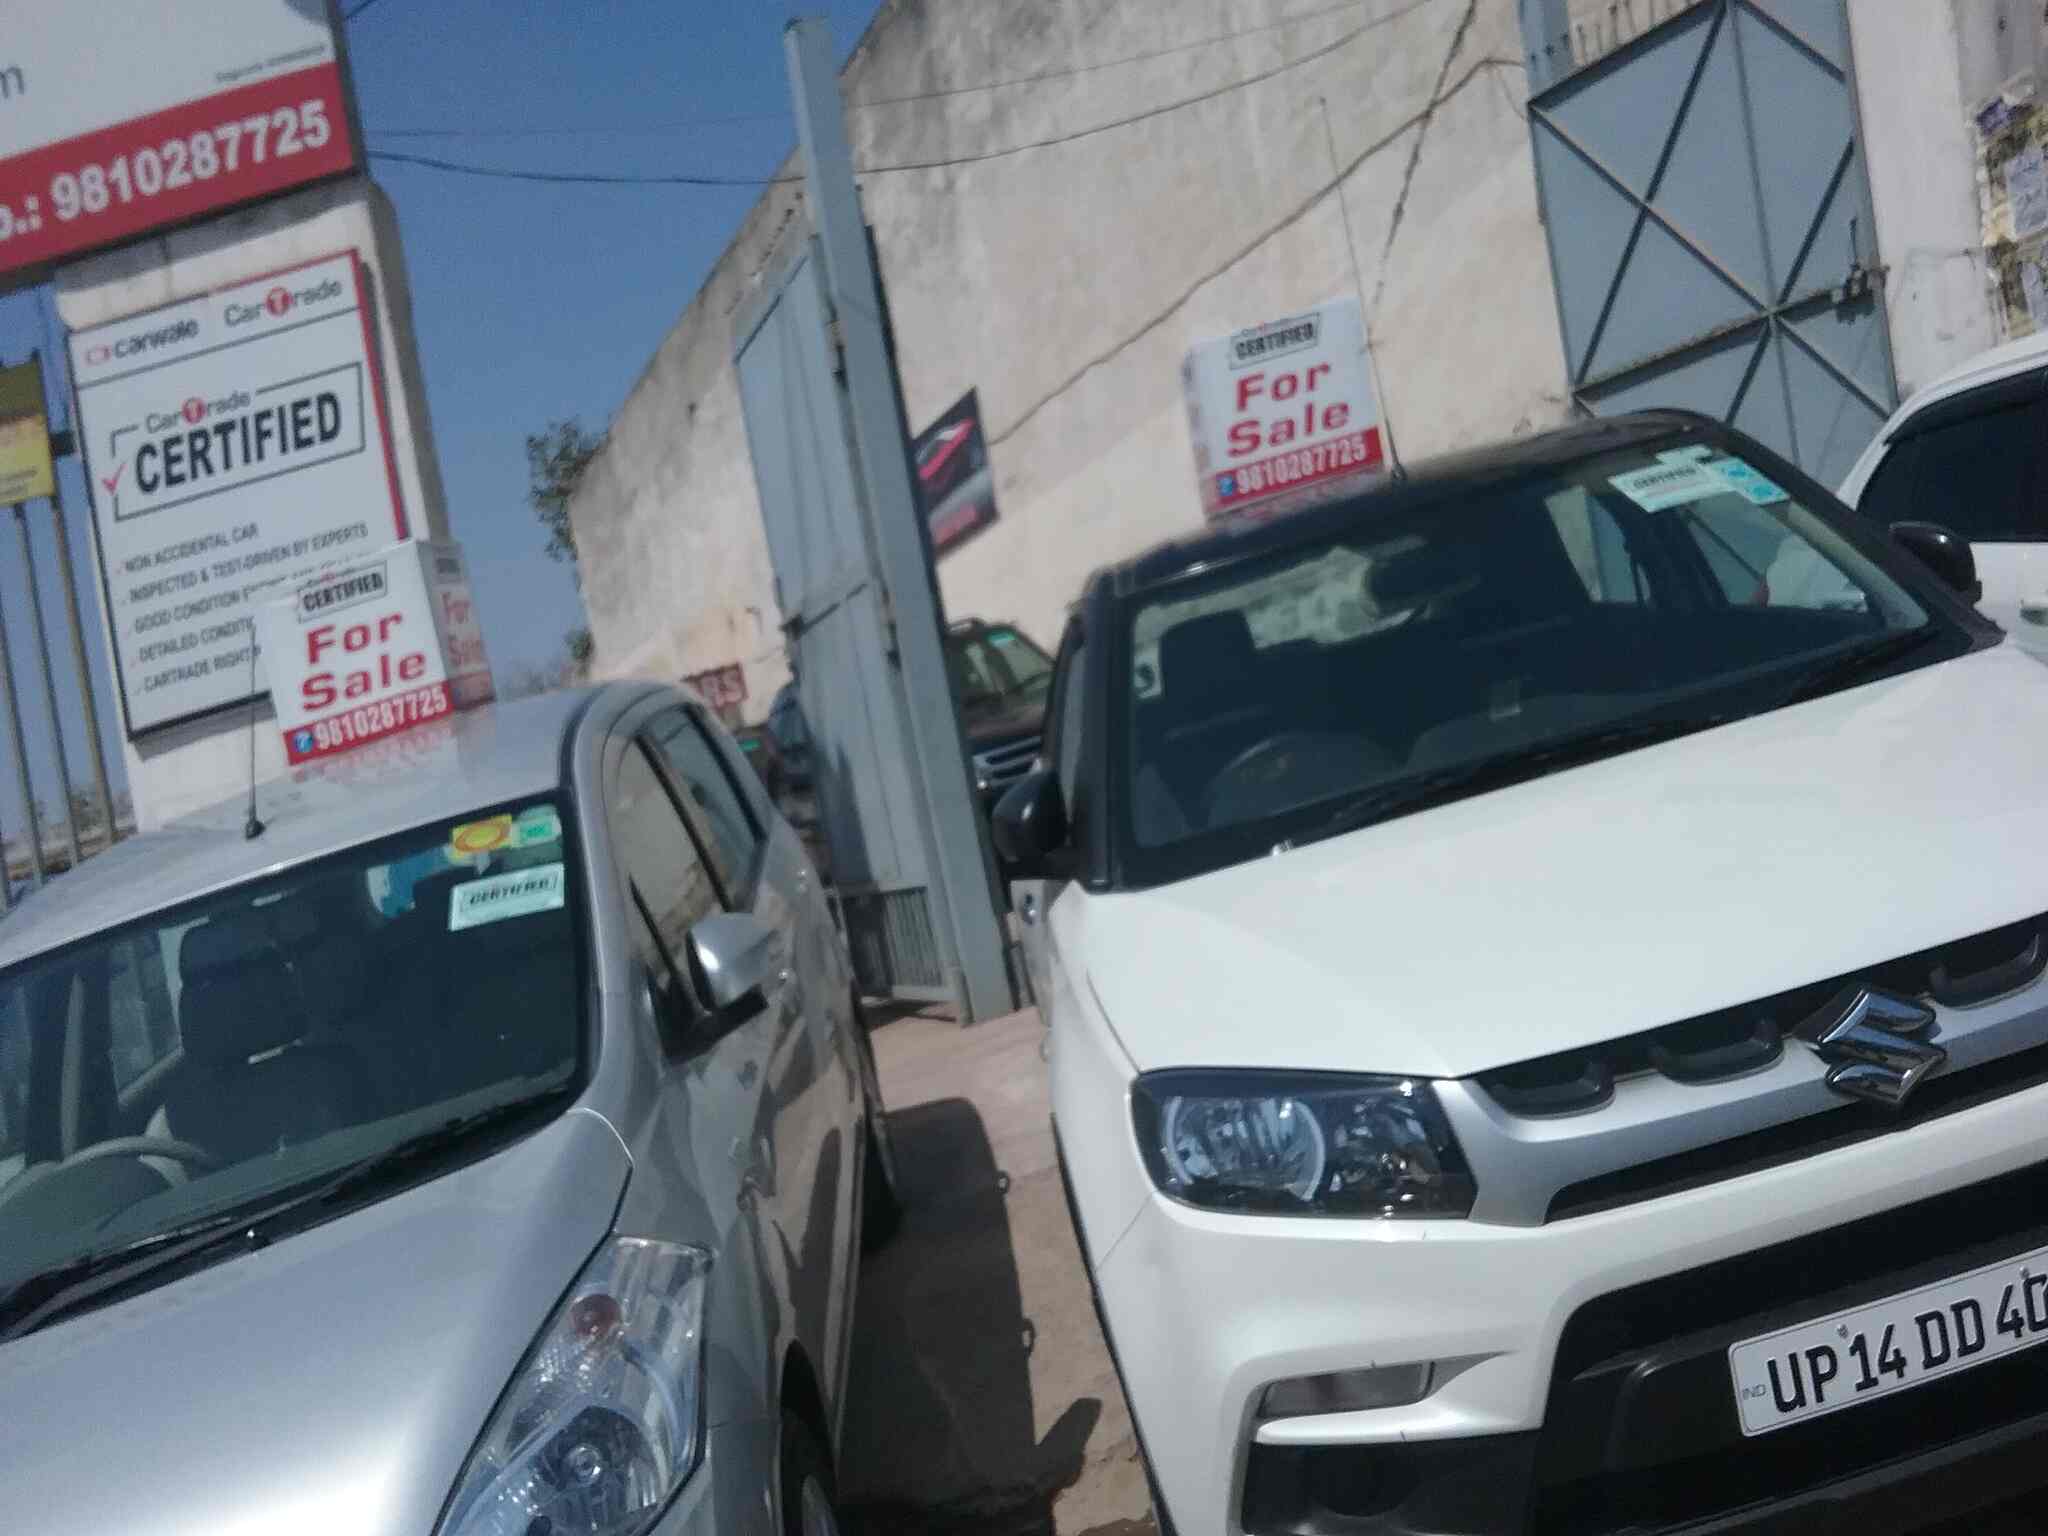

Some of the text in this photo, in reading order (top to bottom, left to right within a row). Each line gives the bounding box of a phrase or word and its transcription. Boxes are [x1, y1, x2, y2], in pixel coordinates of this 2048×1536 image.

[50, 100, 330, 221] 9810287725
[1234, 322, 1314, 360] CERTIFIED
[1236, 362, 1330, 411] For
[135, 391, 342, 494] CERTIFIED
[1227, 402, 1350, 458] Sale
[1235, 435, 1368, 495] 9810287725
[232, 522, 258, 543] CAR
[303, 572, 383, 612] CERTIFIED
[306, 613, 403, 665] For
[302, 652, 426, 711] Sale
[316, 690, 447, 751] 9810287725
[1767, 1343, 1838, 1413] UP
[1849, 1323, 1907, 1392] 14
[1914, 1298, 1985, 1370] DD
